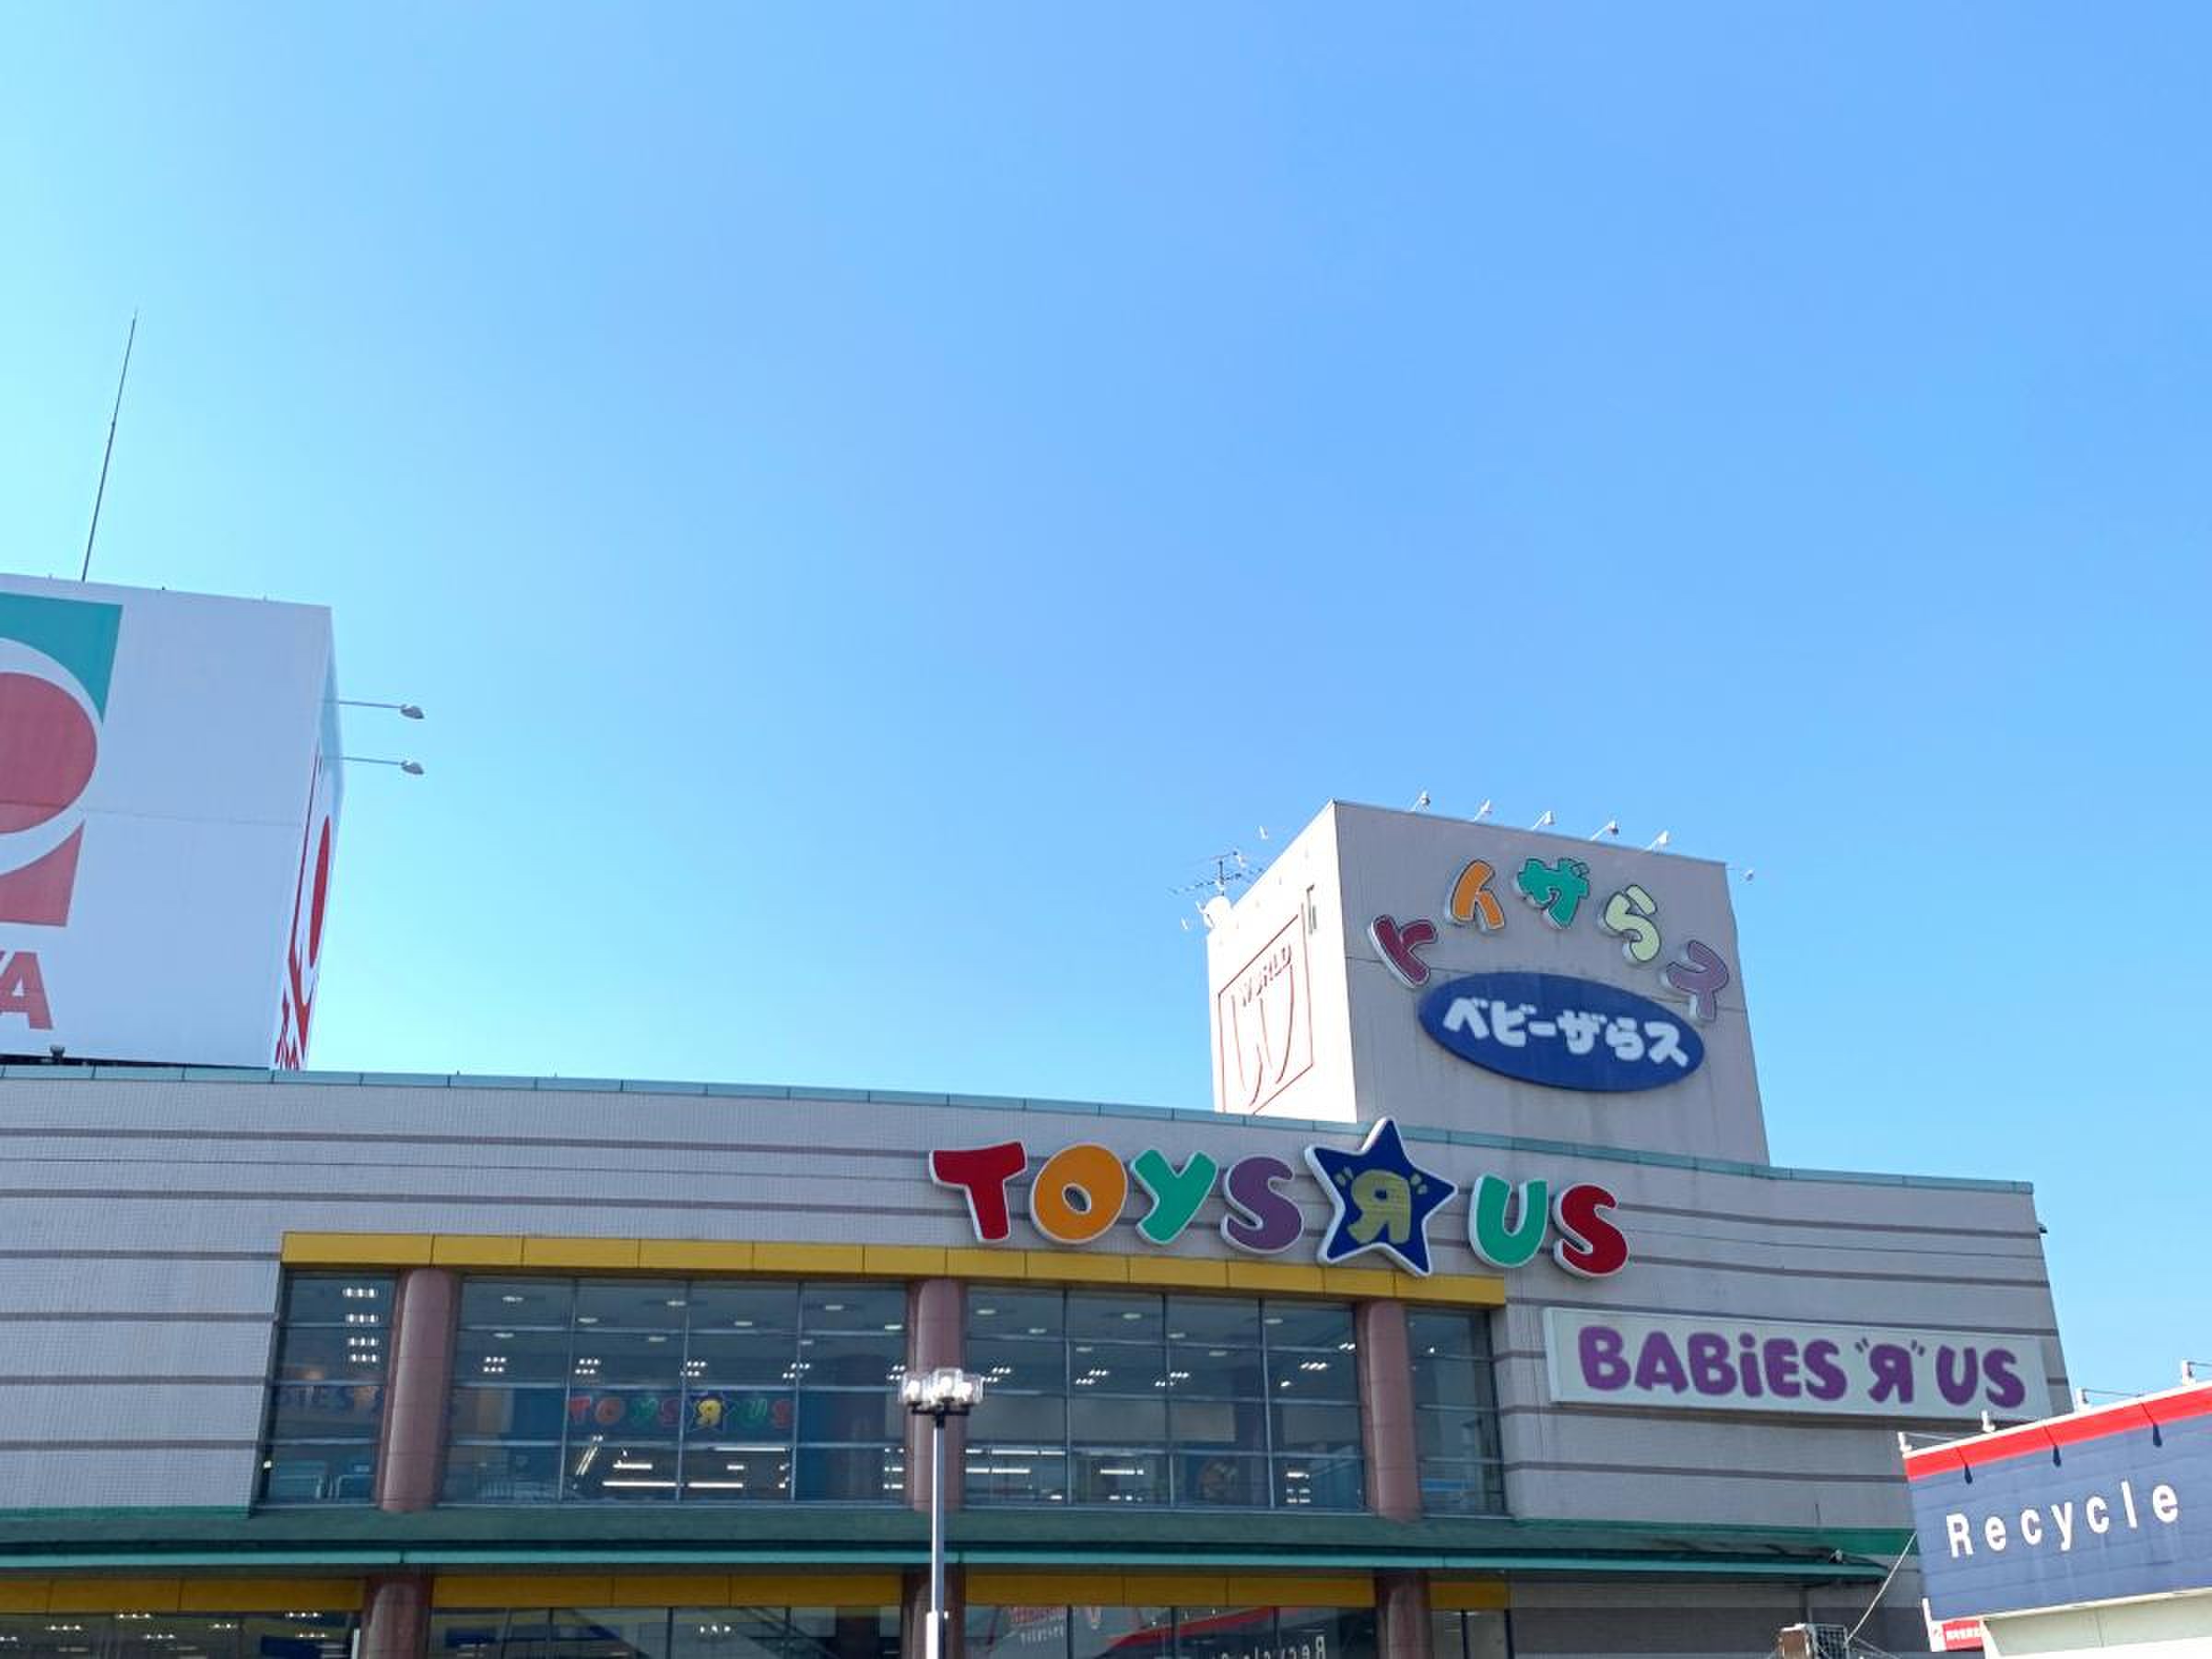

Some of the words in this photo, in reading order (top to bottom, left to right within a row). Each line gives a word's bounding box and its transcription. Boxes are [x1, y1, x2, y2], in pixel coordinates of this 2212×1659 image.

[1372, 858, 1728, 1021] トイザらス
[0, 951, 53, 1030] A
[1443, 996, 1688, 1068] ベビーザらス
[929, 1141, 1304, 1254] TOYS
[1469, 1173, 1629, 1278] US
[1936, 1344, 2027, 1409] US
[1946, 1479, 2181, 1559] Recycle
